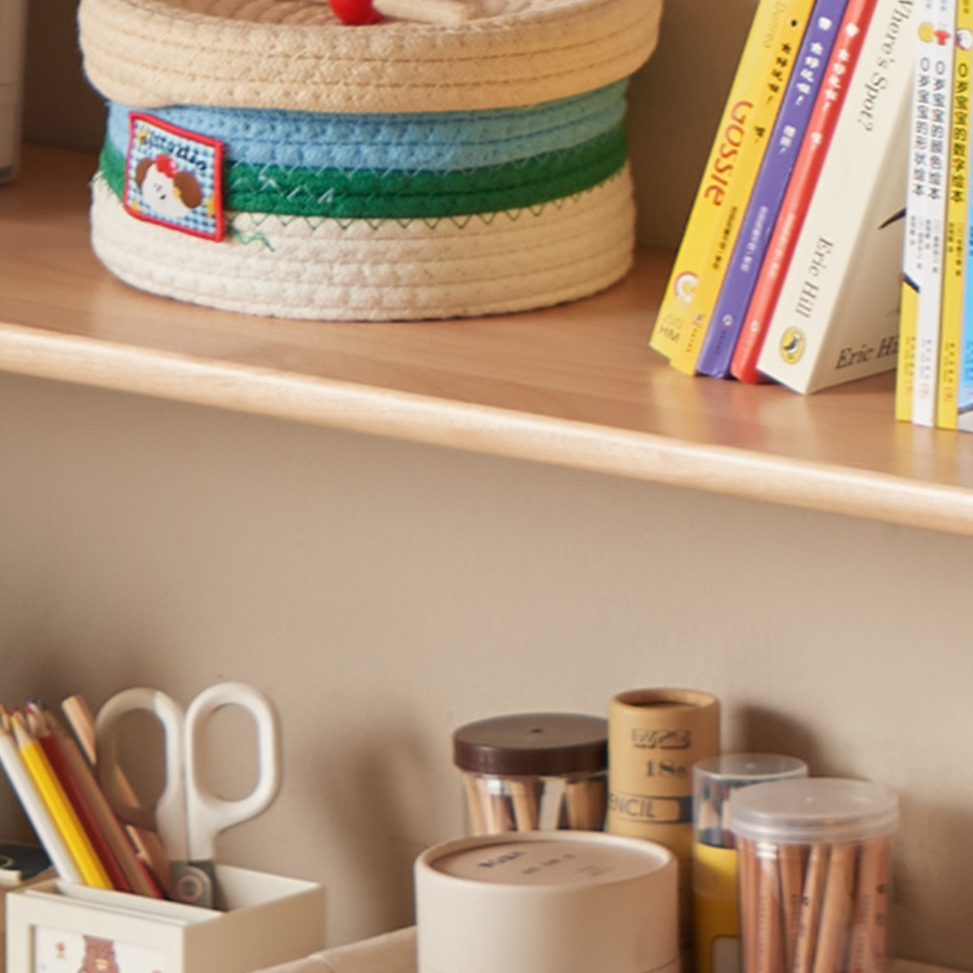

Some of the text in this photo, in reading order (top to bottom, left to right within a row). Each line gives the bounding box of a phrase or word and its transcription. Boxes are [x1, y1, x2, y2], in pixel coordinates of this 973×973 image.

[857, 72, 887, 131] Spot?
[795, 237, 833, 318] Eric Hill
[835, 344, 874, 370] Eric
